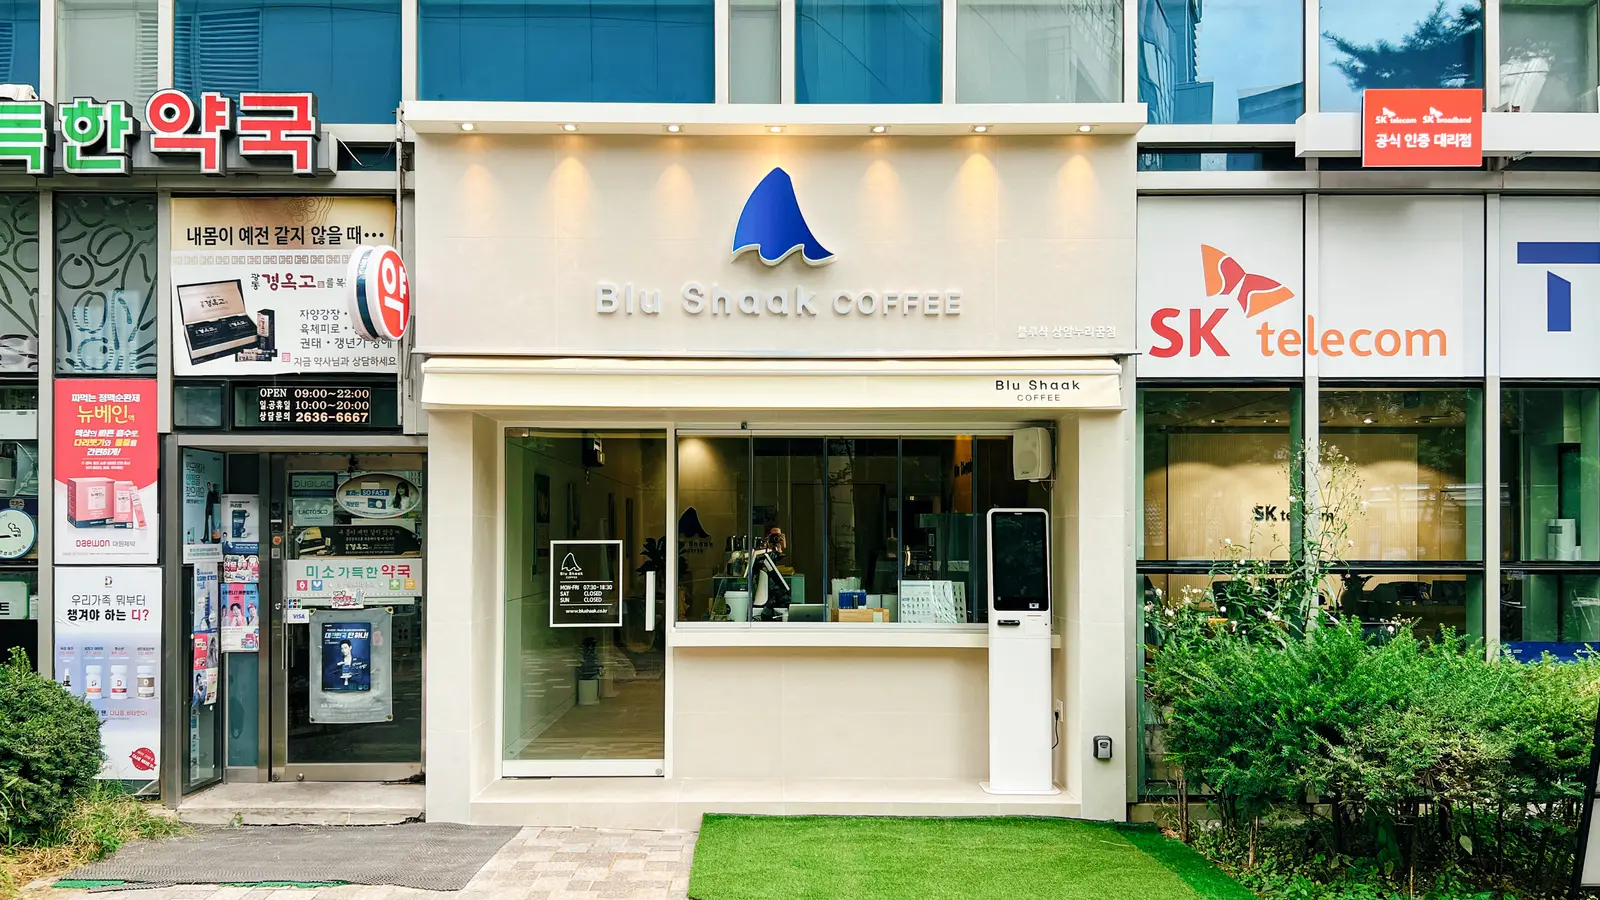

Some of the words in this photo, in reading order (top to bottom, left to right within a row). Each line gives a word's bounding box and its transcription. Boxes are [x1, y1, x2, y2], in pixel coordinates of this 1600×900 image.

[1375, 115, 1388, 124] SK
[1422, 115, 1435, 124] SK
[1436, 116, 1473, 124] broadband
[149, 91, 317, 173] 약국
[1375, 133, 1401, 149] 공식
[1404, 133, 1431, 149] 인증
[1433, 133, 1473, 149] 대리점
[187, 226, 233, 247] 내몸이
[238, 226, 269, 247] 예전
[274, 226, 305, 246] 같지
[310, 225, 342, 247] 않을
[261, 272, 316, 291] 경옥고
[596, 284, 661, 317] Blu
[683, 283, 818, 317] Shaak
[832, 290, 964, 317] COFFEE
[299, 309, 340, 321] 자양강장
[299, 323, 340, 335] 육체피로
[1016, 325, 1049, 340] 블루샥
[1052, 325, 1117, 340] 상암누리꿈점
[1149, 307, 1231, 358] SK
[1255, 314, 1448, 358] telecom
[299, 338, 322, 350] 권태
[293, 357, 312, 368] 지금
[313, 356, 351, 368] 약사님과
[351, 356, 397, 368] 상담하세요
[995, 379, 1021, 391] Blu
[1028, 379, 1081, 391] Shaak
[259, 388, 288, 398] OPEN
[294, 388, 370, 399] 09:00~22:00
[1016, 394, 1061, 402] COFFEE
[295, 400, 370, 411] 10:00~20:00
[259, 411, 291, 422] 상담문의
[295, 412, 370, 423] 2636-6667
[1254, 505, 1278, 522] SK
[381, 564, 411, 579] 약국
[71, 594, 112, 607] 우리가족
[67, 608, 101, 621] 챙겨야
[104, 608, 127, 621] 하는
[131, 608, 150, 621] 디?
